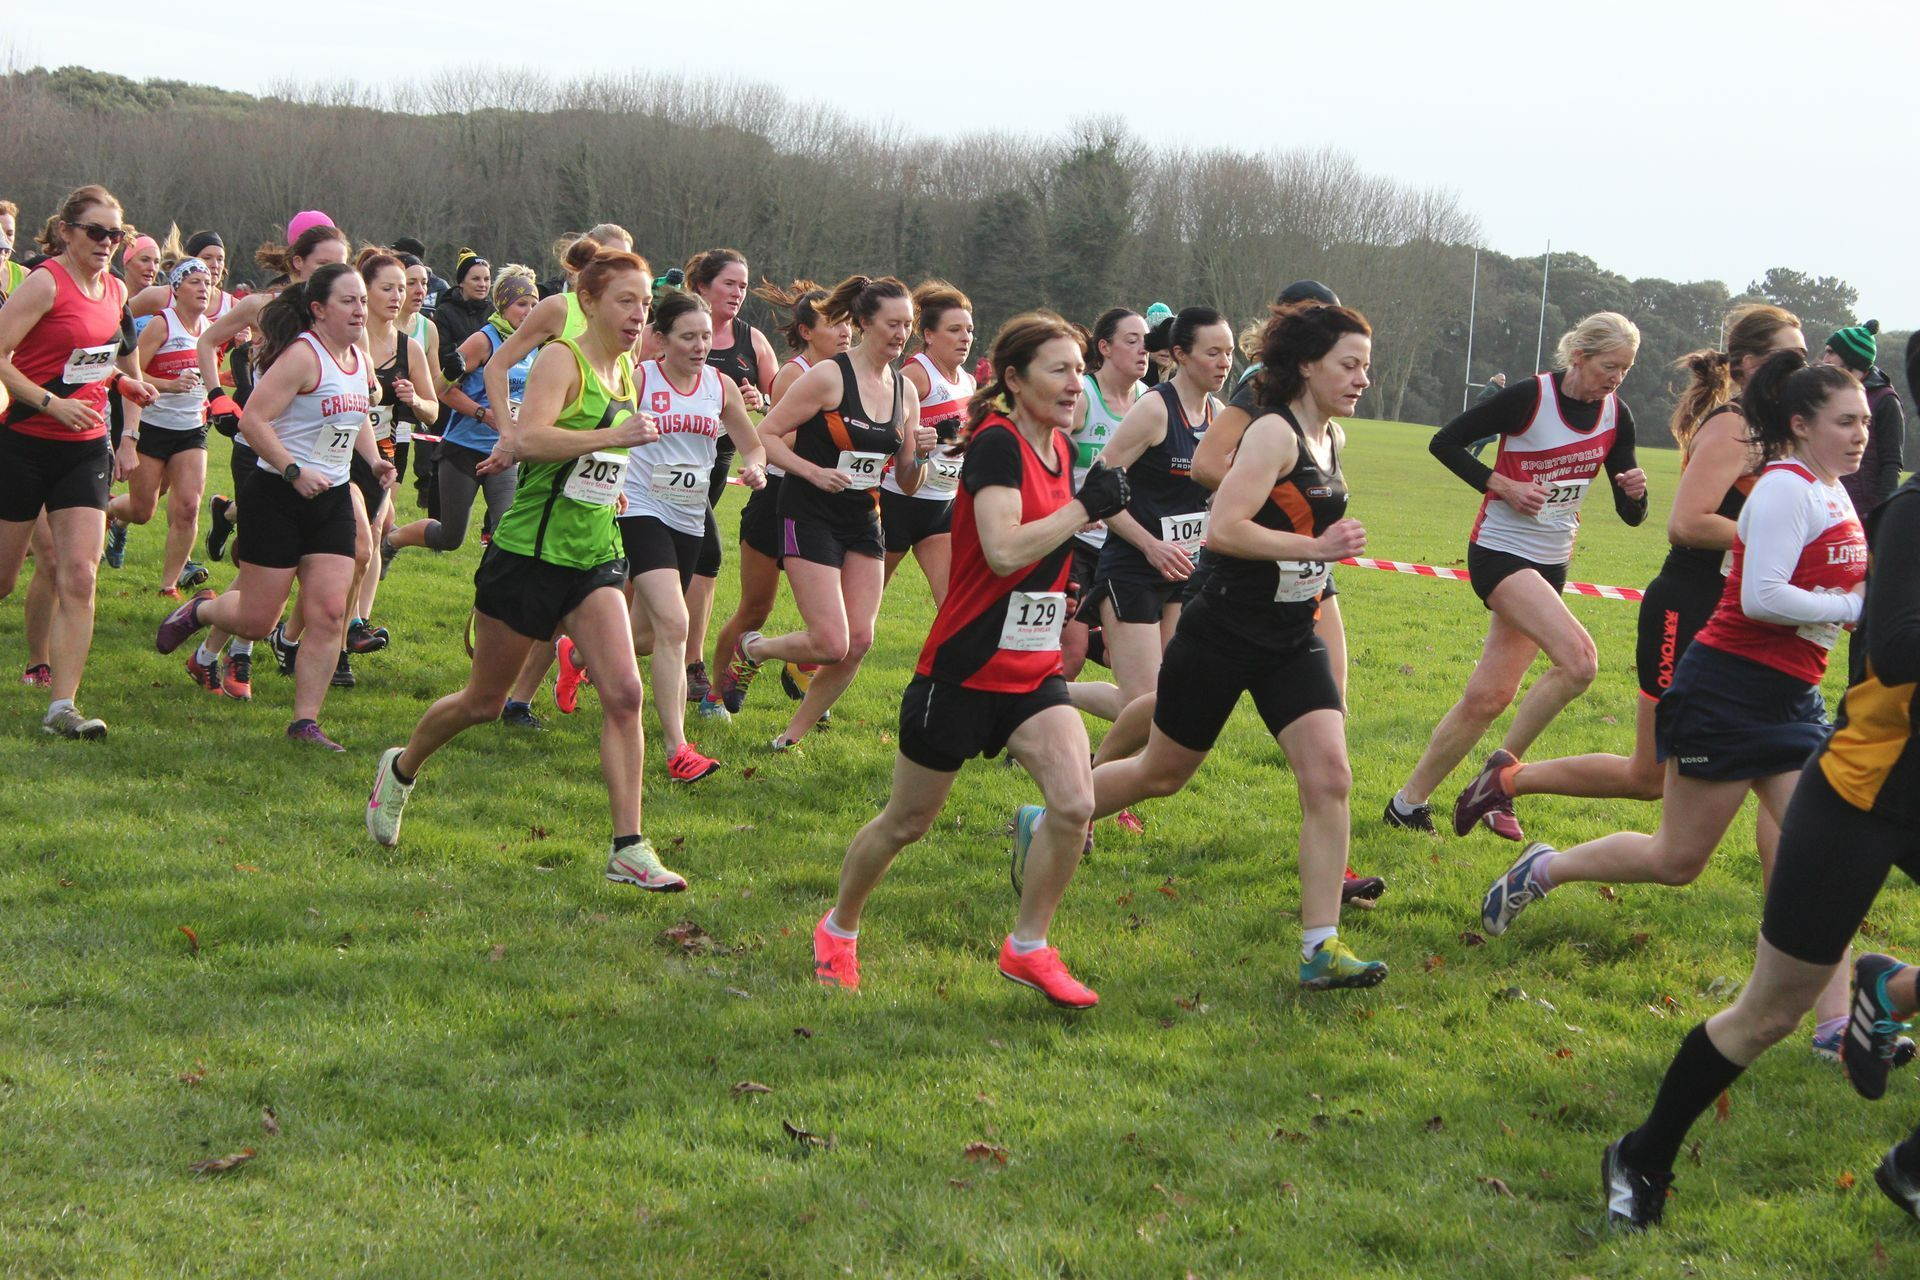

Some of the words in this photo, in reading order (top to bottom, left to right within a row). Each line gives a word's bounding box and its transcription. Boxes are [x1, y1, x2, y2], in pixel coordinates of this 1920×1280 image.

[73, 352, 110, 366] 128
[330, 432, 350, 449] 72
[578, 459, 621, 485] 203
[850, 458, 875, 474] 46
[1533, 466, 1572, 486] RUNNING
[1574, 462, 1597, 474] CLUB
[668, 471, 696, 489] 70
[1546, 484, 1580, 503] 221
[1171, 521, 1202, 542] 104
[1017, 603, 1057, 627] 129
